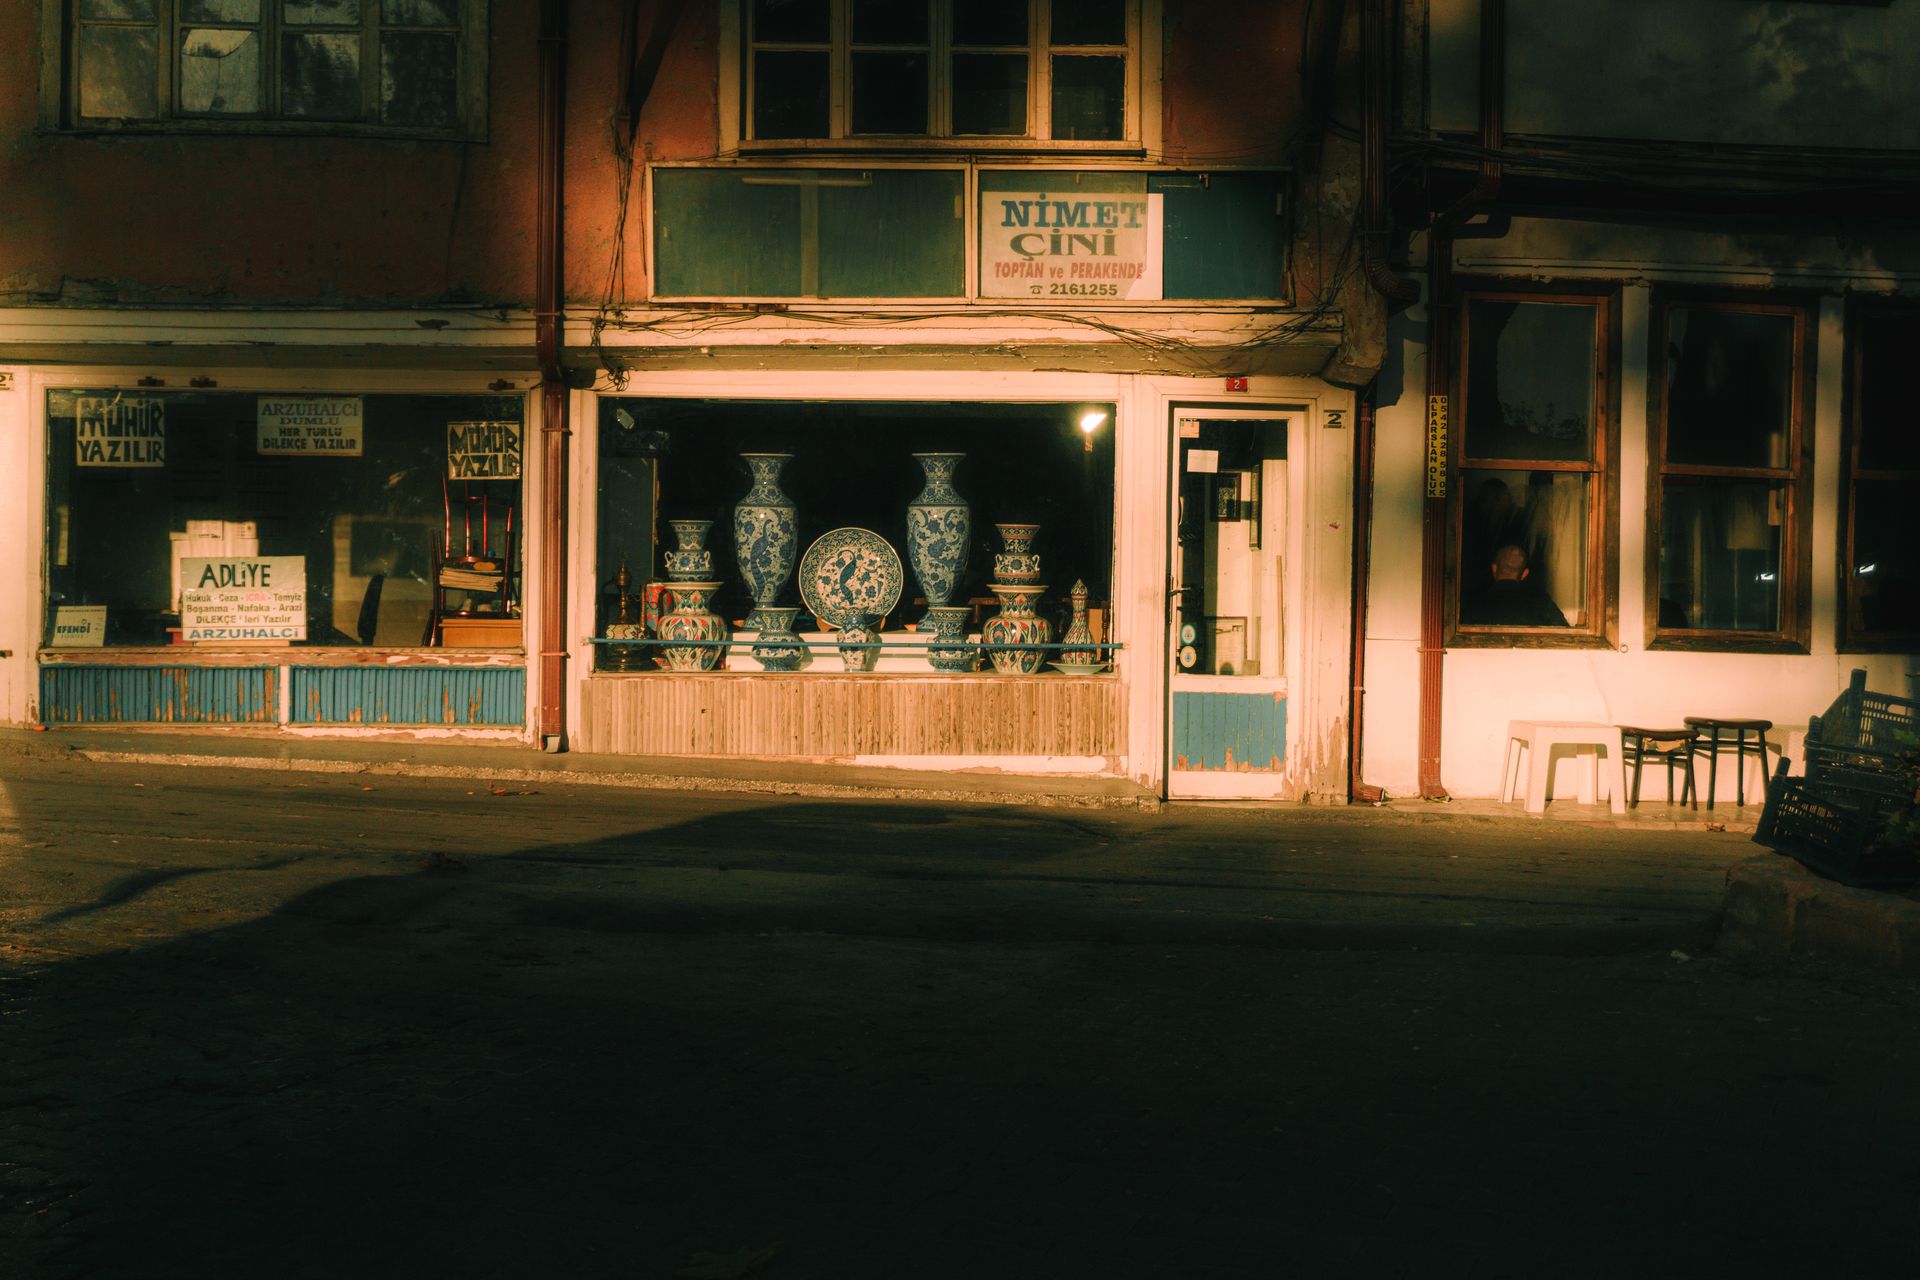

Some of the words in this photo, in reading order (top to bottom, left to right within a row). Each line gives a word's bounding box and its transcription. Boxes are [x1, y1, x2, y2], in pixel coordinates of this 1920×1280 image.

[1001, 193, 1146, 228] NİMET
[1010, 229, 1117, 261] ÇİNİ
[995, 262, 1044, 278] TOPTAN
[1050, 266, 1064, 278] ve
[1071, 262, 1143, 279] PERAKENDE
[1050, 283, 1118, 296] 2161255
[79, 398, 164, 437] MÜHÜR
[1328, 413, 1342, 425] 2
[280, 428, 301, 437] HER
[306, 428, 342, 437] TÜRLÜ
[450, 425, 518, 453] MÜHÜR
[1430, 397, 1438, 463] ALPARSLAN
[78, 440, 164, 462] YAZILIR
[263, 438, 307, 451] DİLEKÇE
[313, 439, 356, 449] YAZILIR
[1429, 466, 1437, 496] OLUK
[198, 562, 271, 588] ADLİYE
[186, 594, 211, 602] Hukuk
[237, 604, 270, 612] Nafaka
[264, 615, 292, 624] Yazılır
